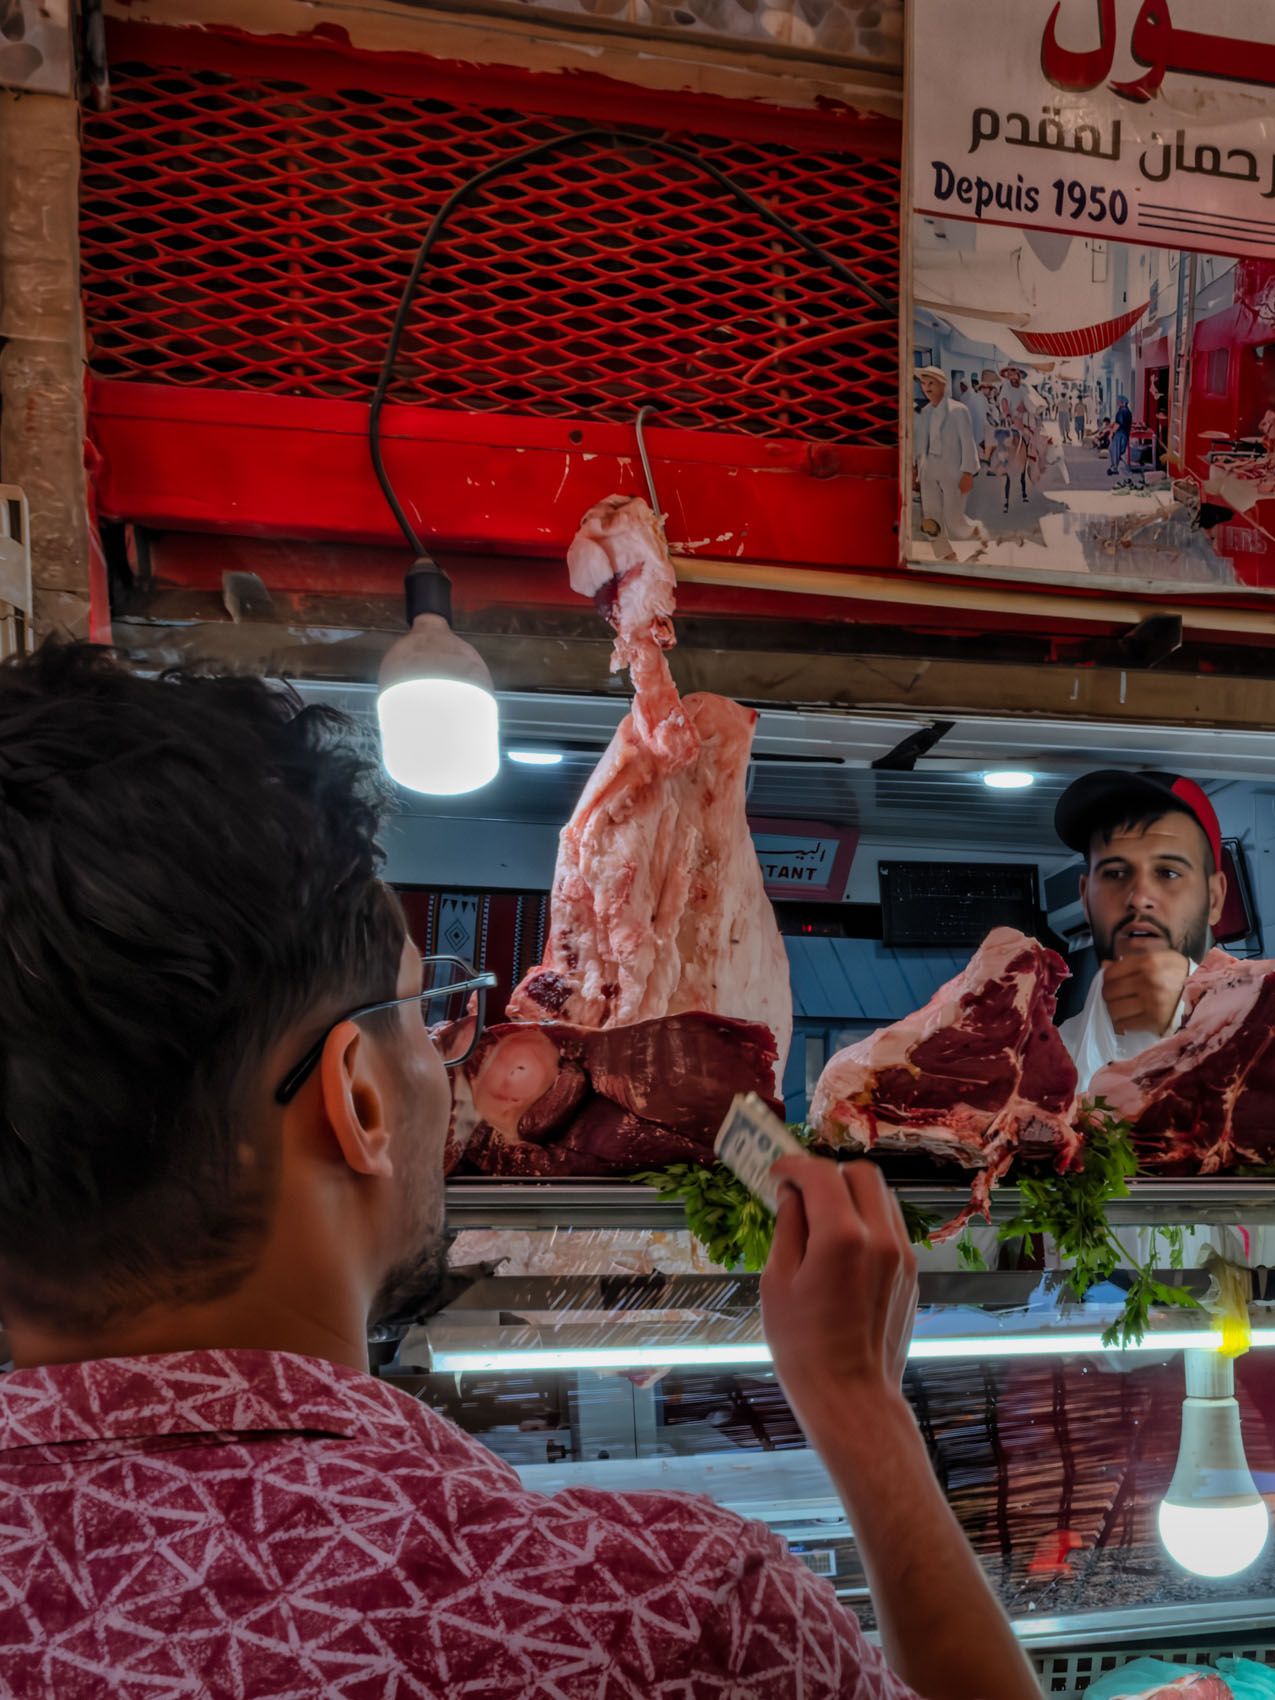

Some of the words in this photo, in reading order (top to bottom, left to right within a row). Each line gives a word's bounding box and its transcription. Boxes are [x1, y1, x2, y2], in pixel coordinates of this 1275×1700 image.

[967, 105, 1122, 162] لمقدم
[930, 160, 1041, 220] Depuis
[1051, 177, 1129, 226] 1950
[760, 864, 817, 881] TANT
